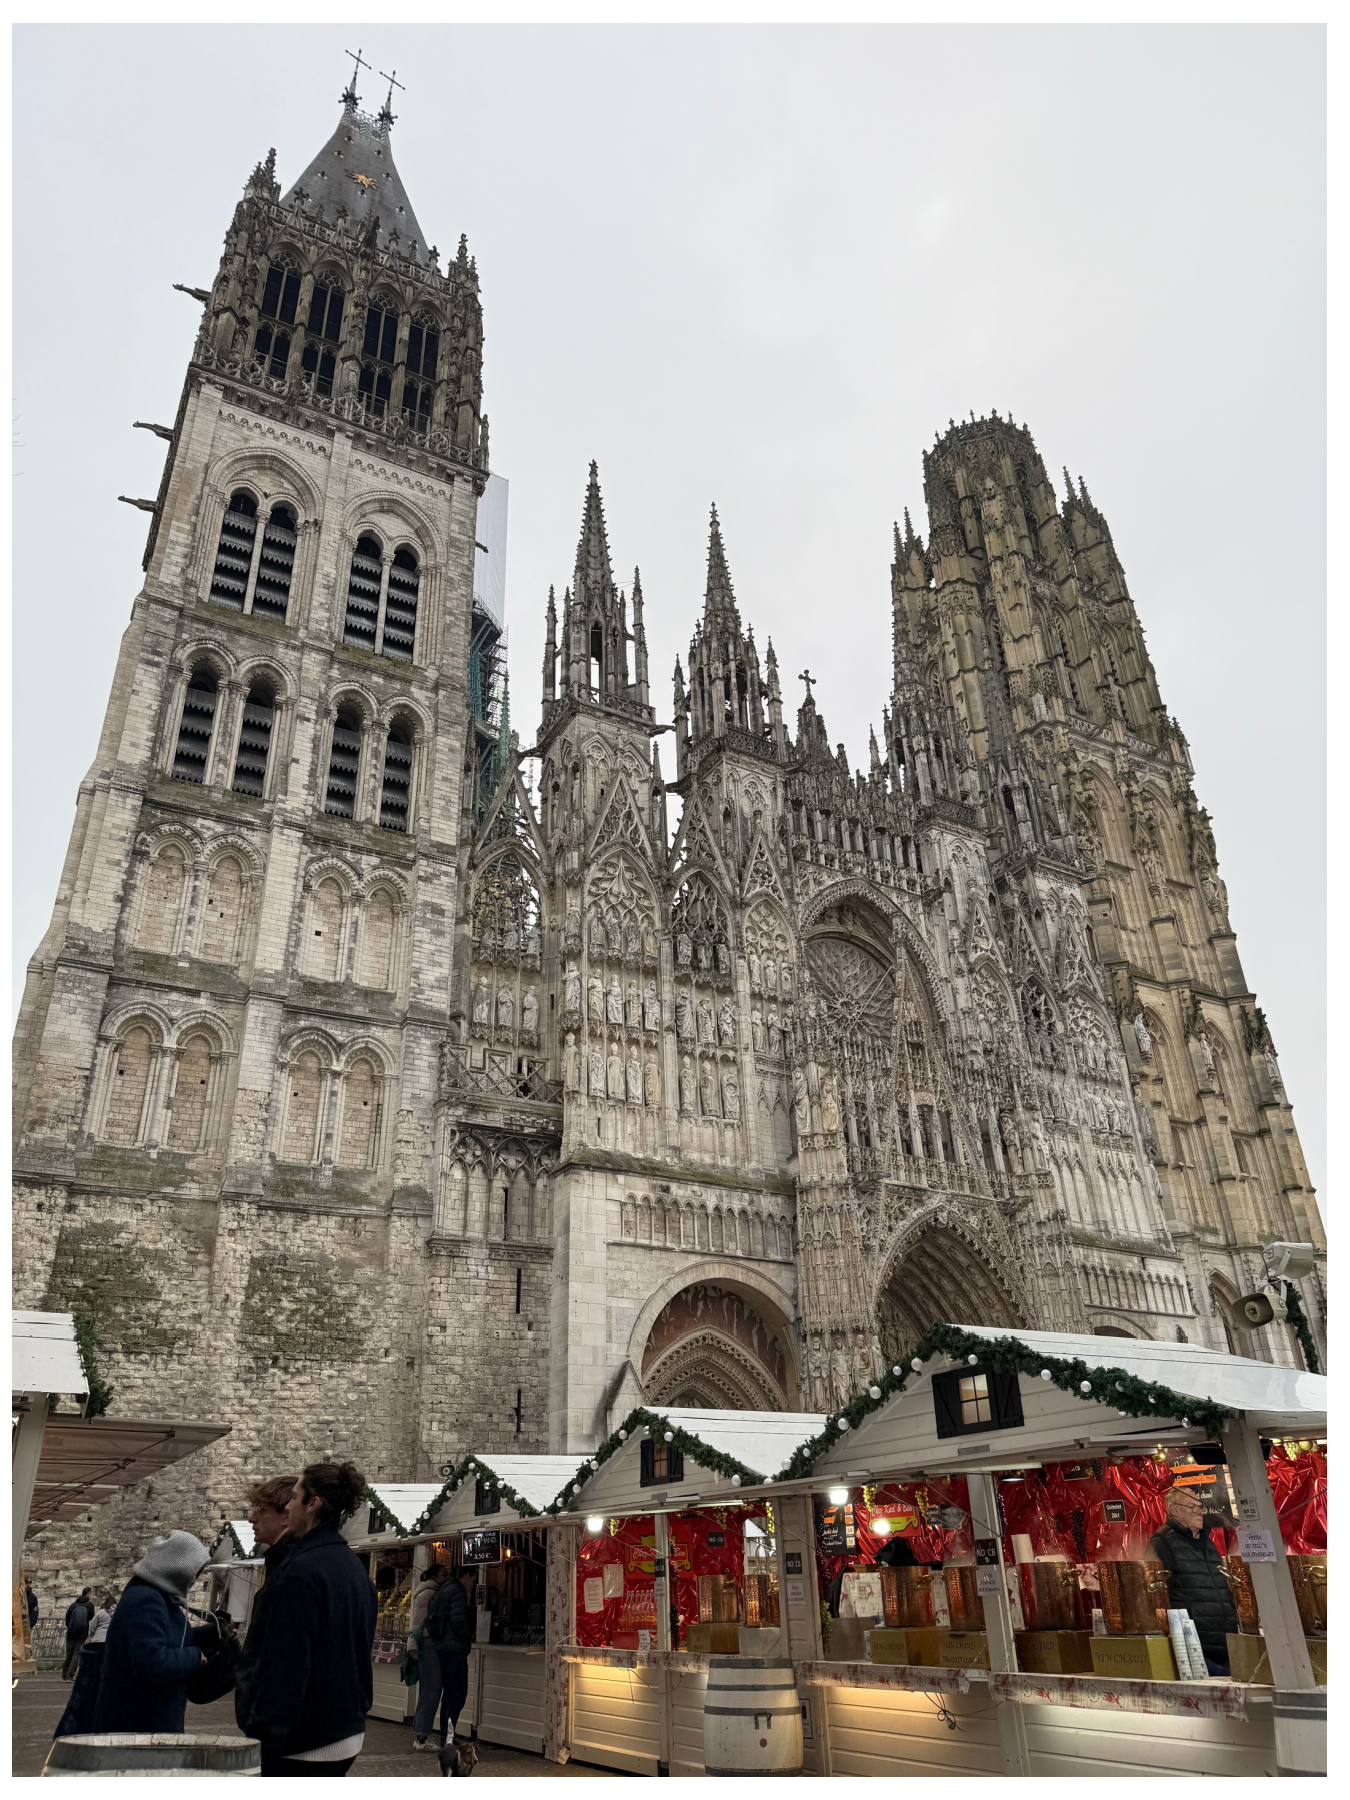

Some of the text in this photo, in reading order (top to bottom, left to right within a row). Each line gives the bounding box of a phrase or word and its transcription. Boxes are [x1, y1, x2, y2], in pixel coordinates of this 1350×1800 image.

[871, 1505, 883, 1517] Chez
[885, 1642, 905, 1651] CHAUD
[944, 1641, 976, 1650] VIN CHAUD
[1095, 1652, 1147, 1663] VIN CHAUD
